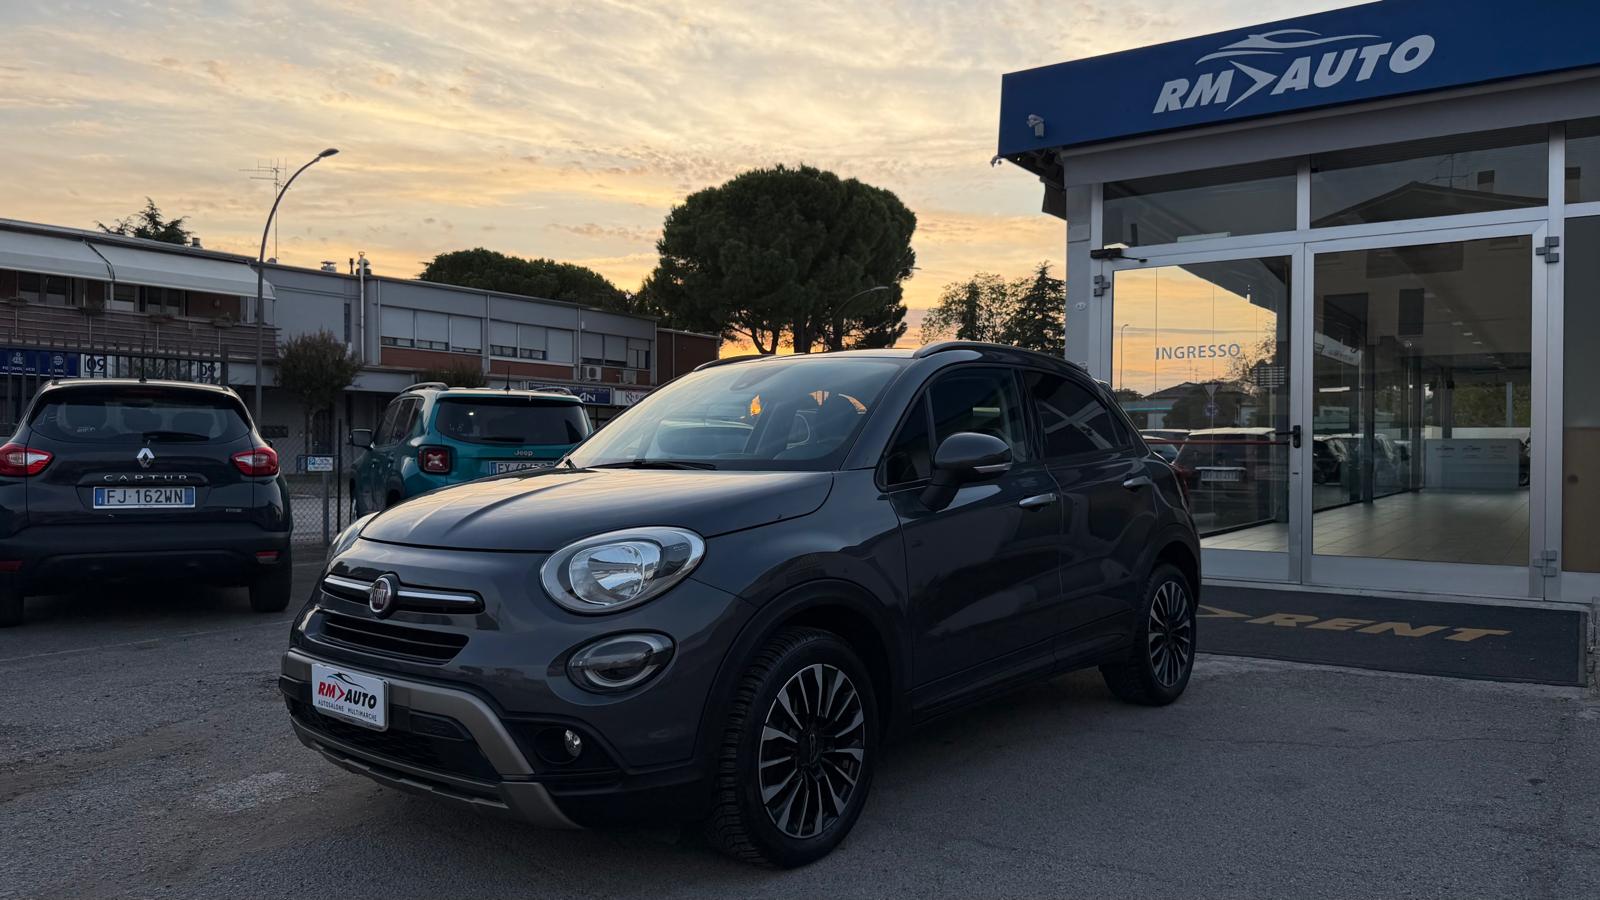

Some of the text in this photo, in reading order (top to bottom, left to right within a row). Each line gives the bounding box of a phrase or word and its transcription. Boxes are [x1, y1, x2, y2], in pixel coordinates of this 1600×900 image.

[1153, 34, 1436, 114] RM AUTO
[1155, 343, 1241, 361] INGRESSO
[514, 449, 534, 457] Jeep
[107, 489, 183, 504] FJ 162WN
[1245, 612, 1513, 642] RENT
[318, 681, 377, 710] RM AUTO
[318, 699, 377, 722] AUTOSALONE MULTIMARCHE
